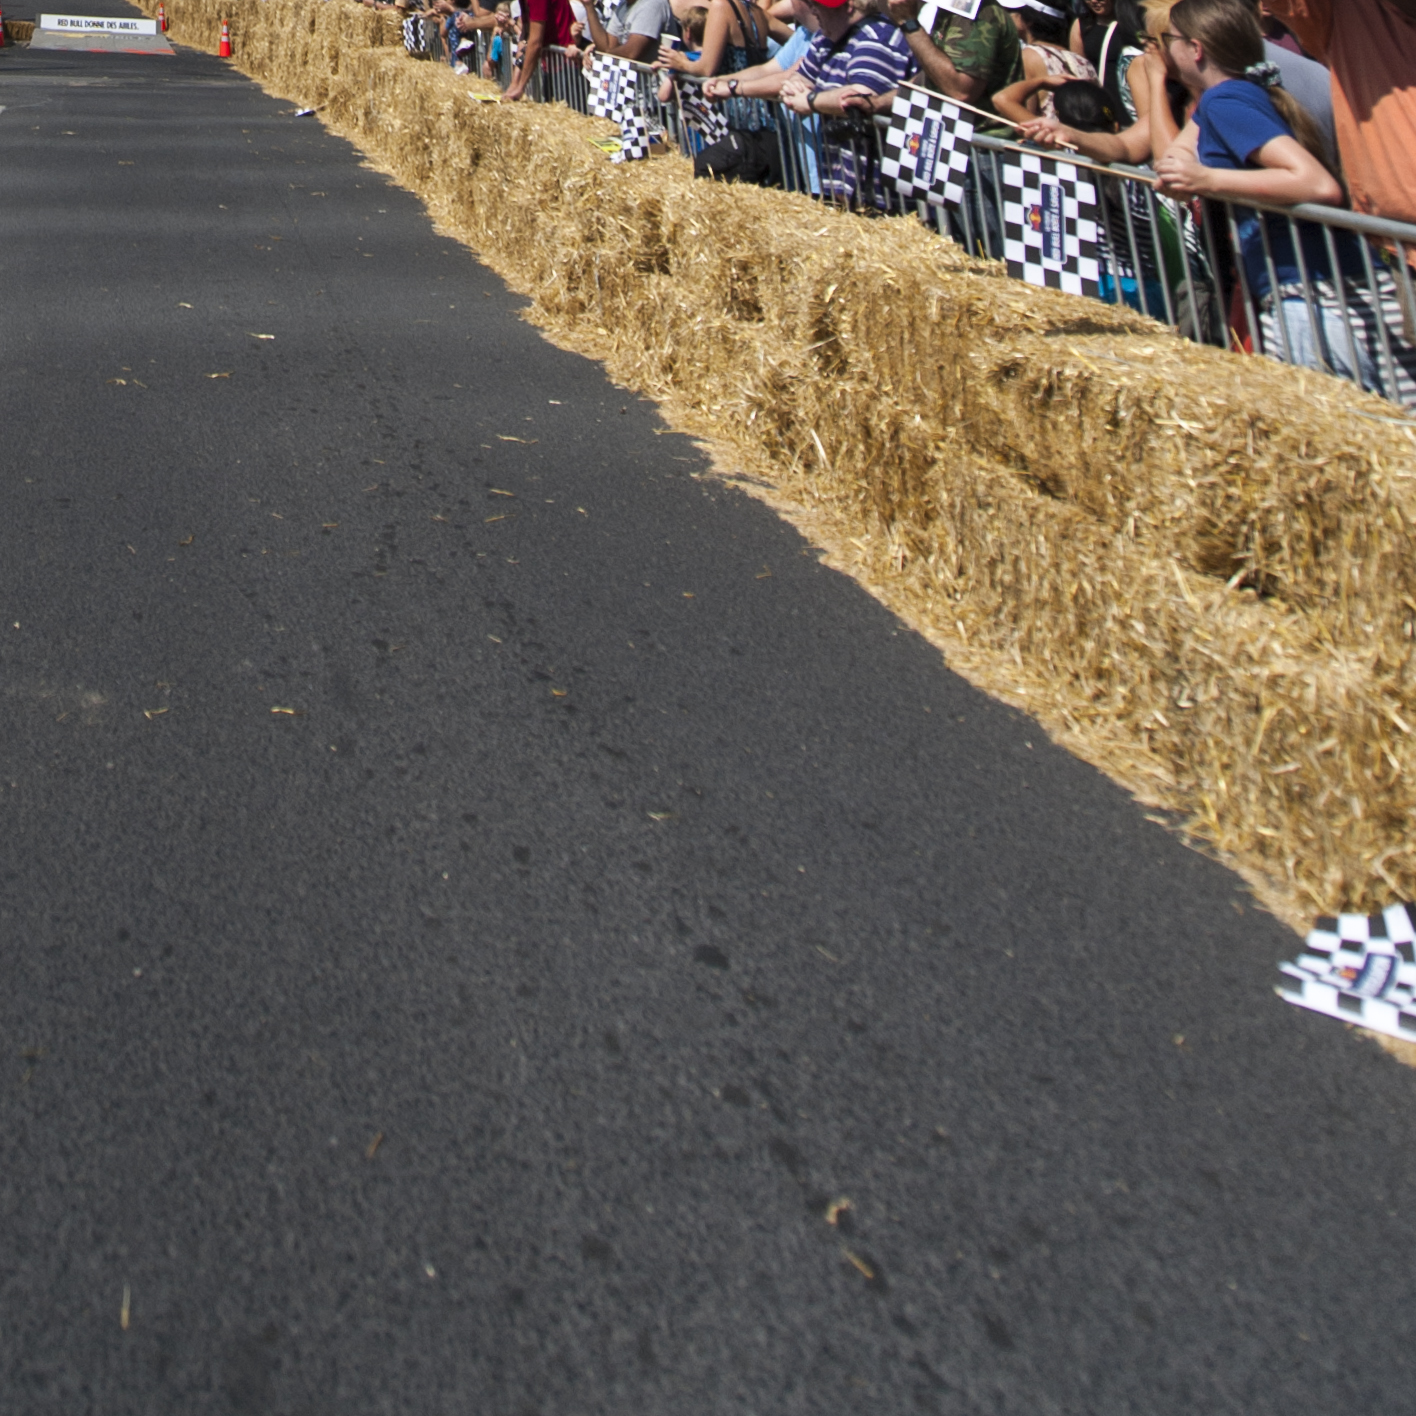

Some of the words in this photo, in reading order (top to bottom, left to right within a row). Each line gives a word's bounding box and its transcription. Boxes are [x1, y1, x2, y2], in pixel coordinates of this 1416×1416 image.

[57, 18, 69, 27] RED
[70, 19, 83, 28] BULL
[84, 20, 105, 29] DONNE
[106, 21, 117, 30] DES
